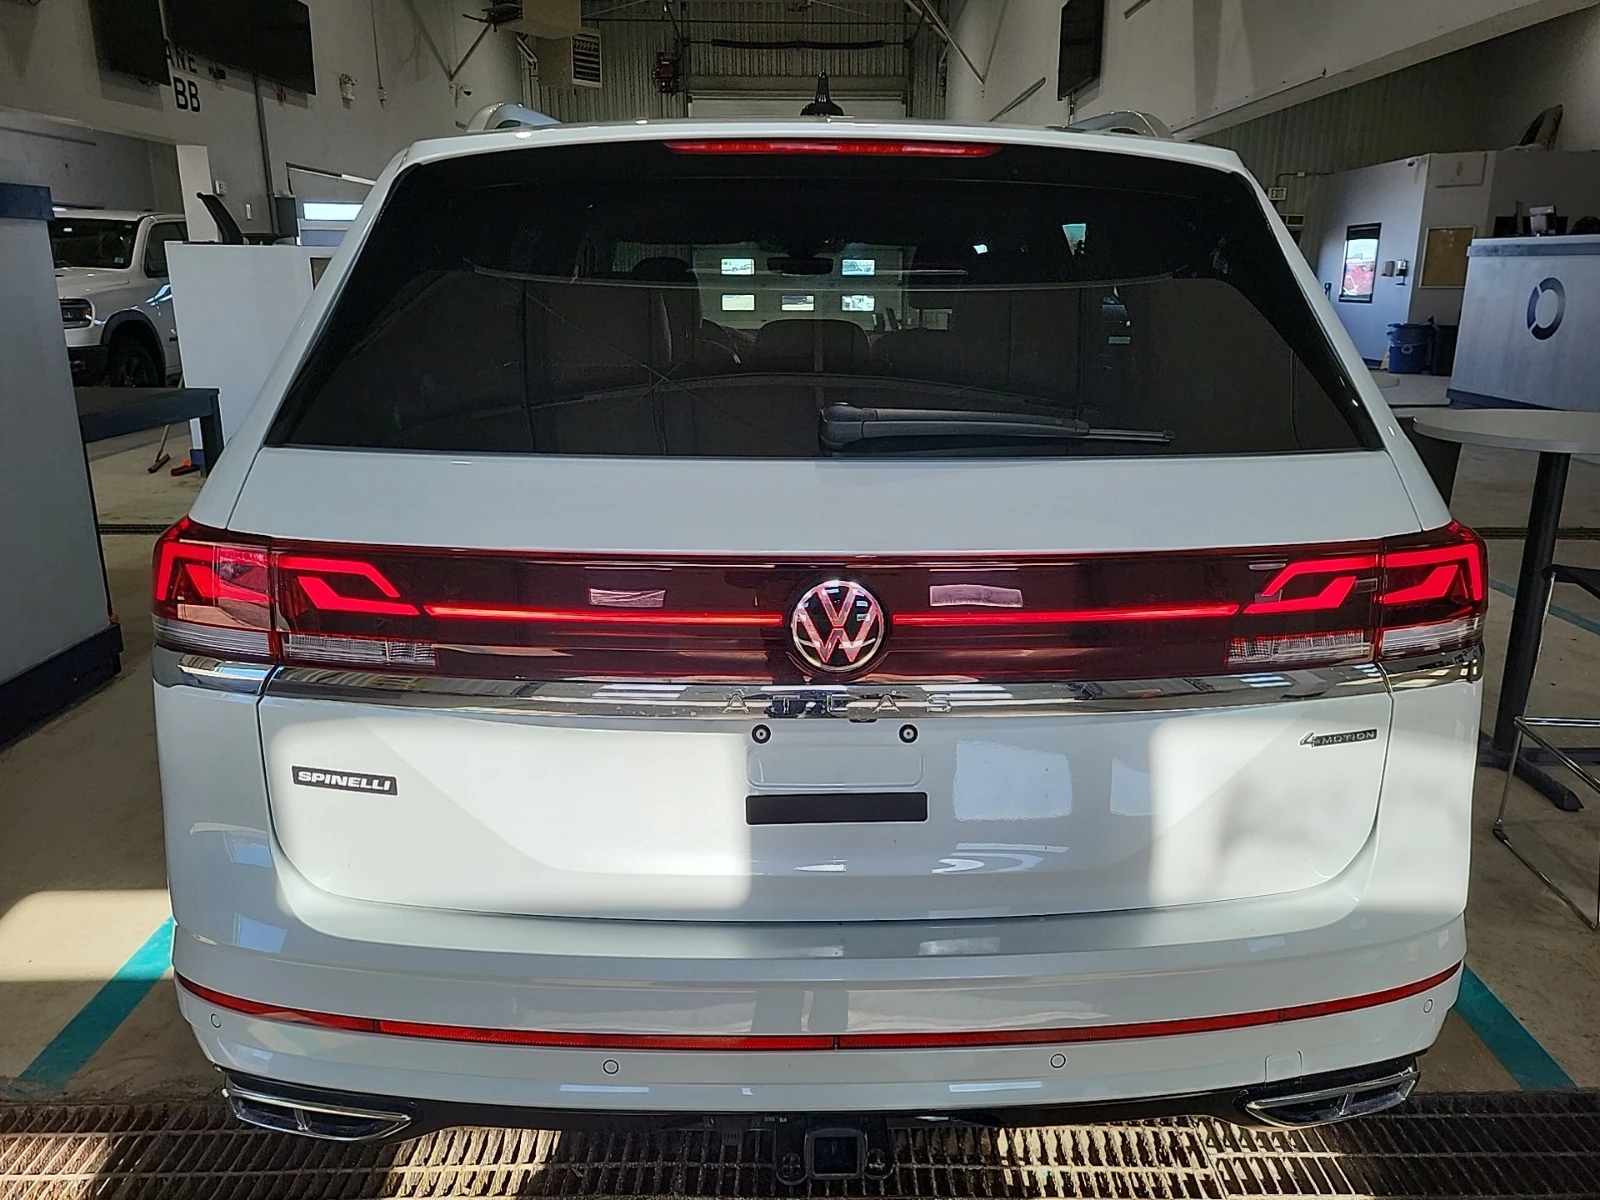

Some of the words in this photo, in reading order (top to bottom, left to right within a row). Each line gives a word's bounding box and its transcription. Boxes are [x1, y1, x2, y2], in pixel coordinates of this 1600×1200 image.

[164, 39, 198, 74] ANE
[173, 76, 200, 112] BB
[794, 581, 883, 667] VW
[723, 693, 952, 714] ATLAS
[297, 770, 391, 791] SPINELLI
